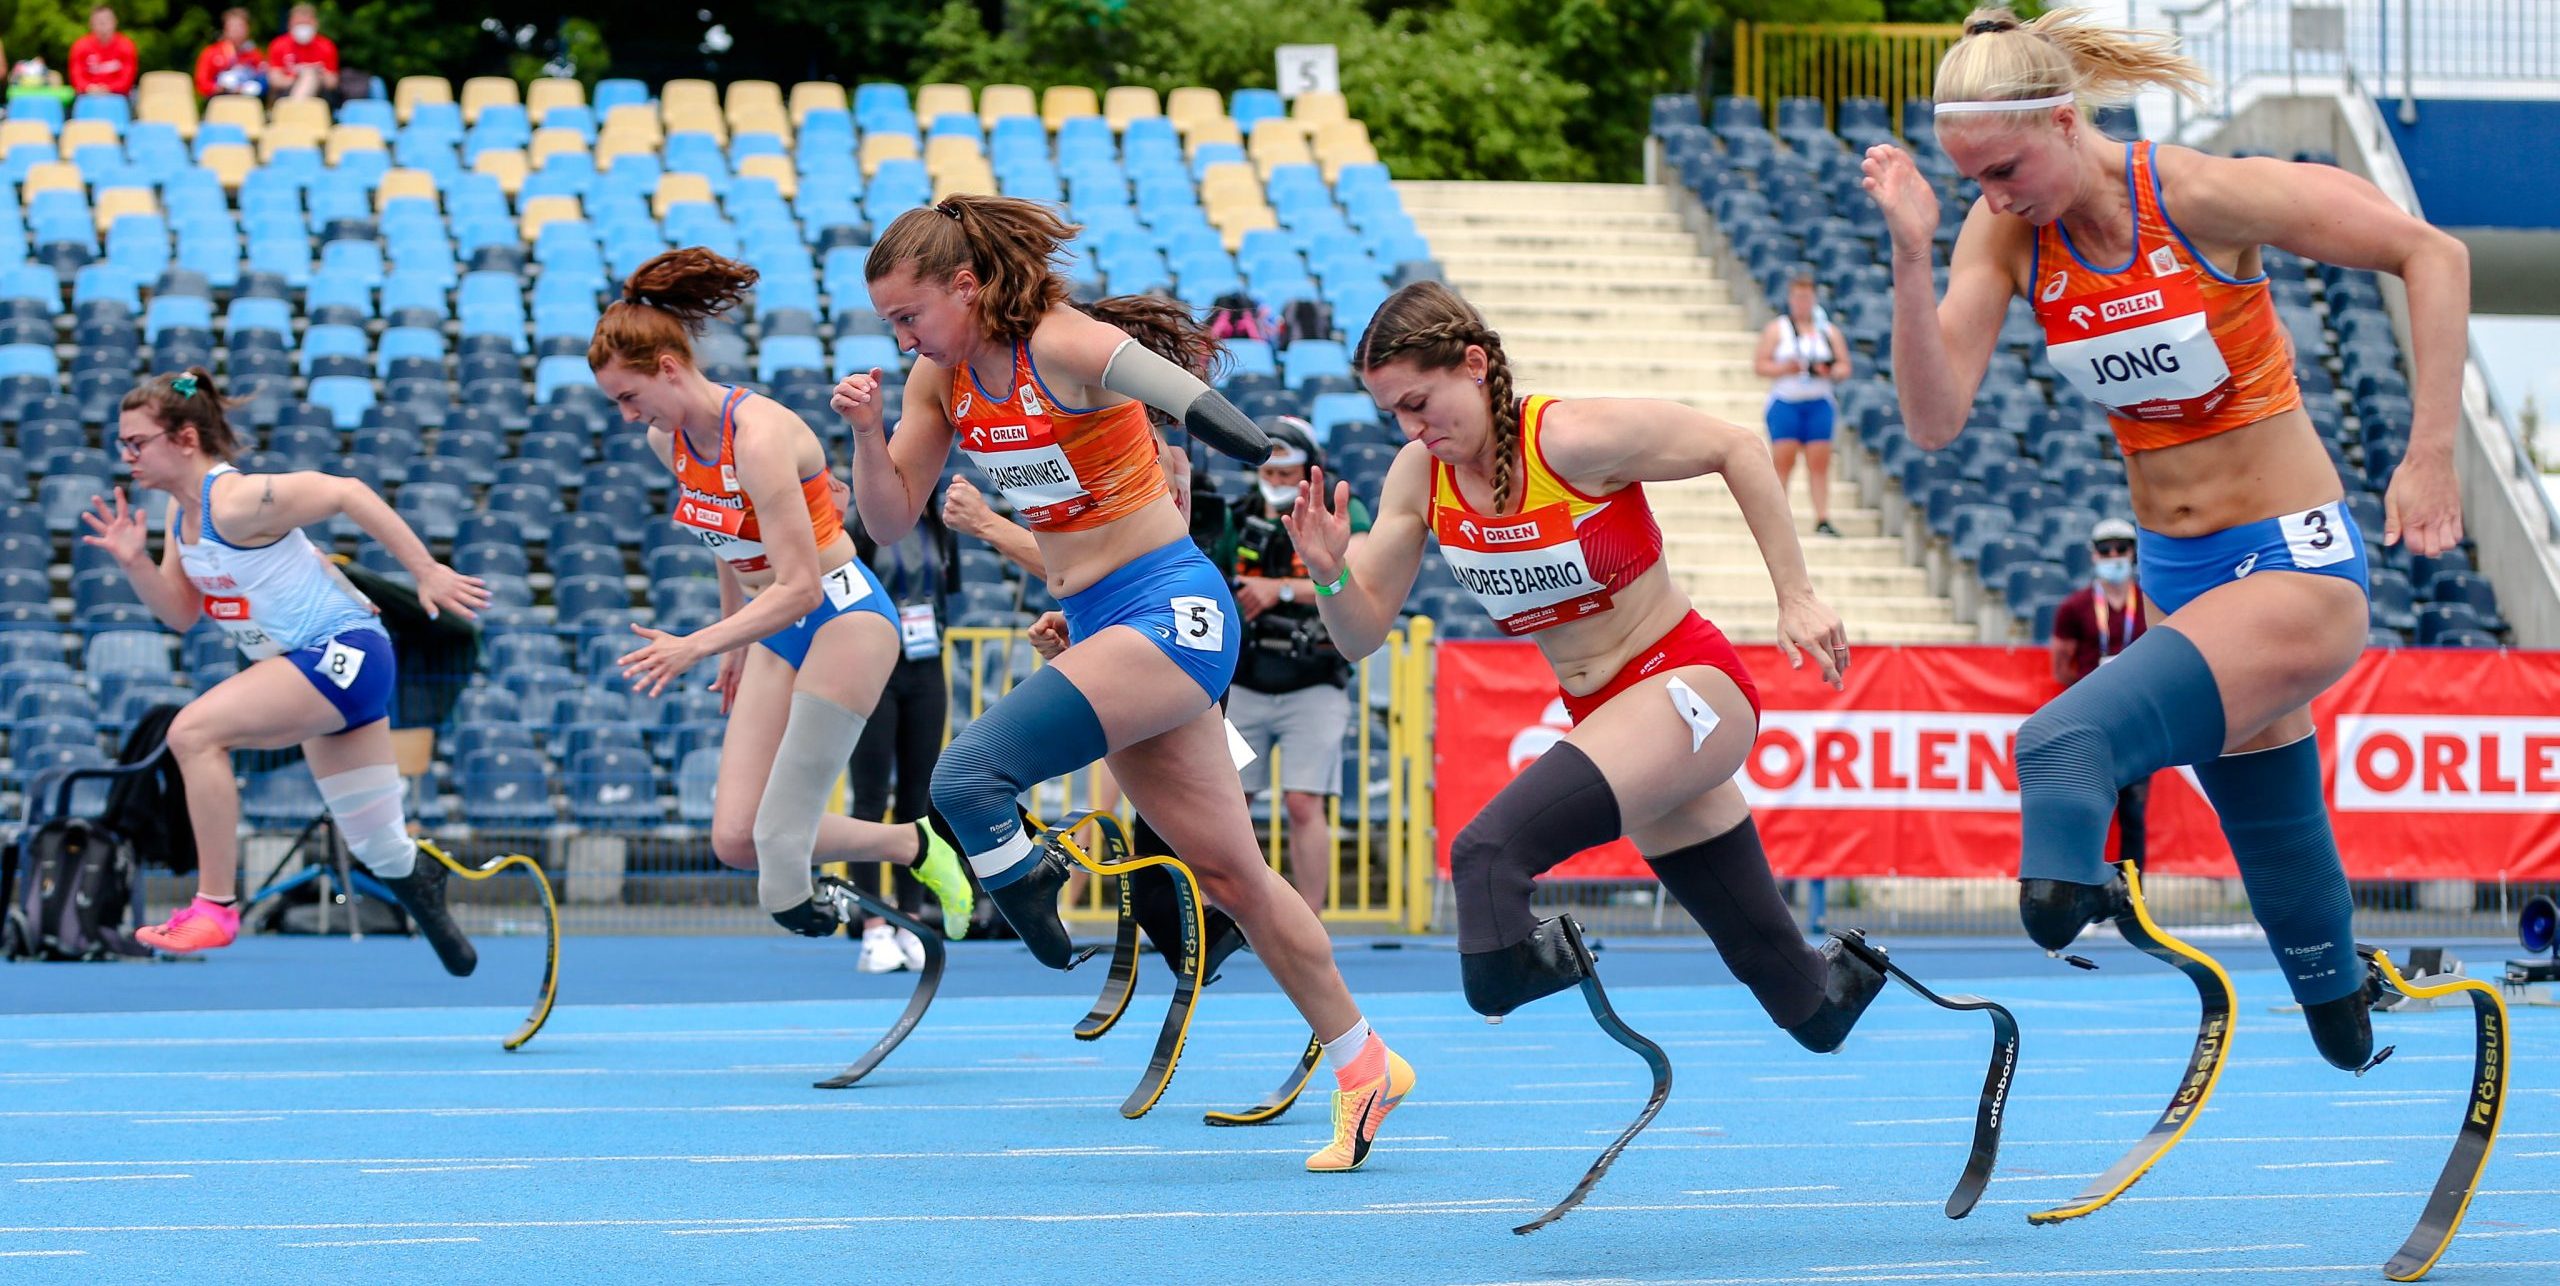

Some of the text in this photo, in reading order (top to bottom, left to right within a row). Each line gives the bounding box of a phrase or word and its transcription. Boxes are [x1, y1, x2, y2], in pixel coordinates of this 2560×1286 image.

[1300, 61, 1318, 91] 5
[2106, 293, 2158, 318] ORLEN
[2090, 342, 2180, 385] JONG
[992, 427, 1025, 441] ORLEN
[1486, 525, 1535, 541] ORLEN
[2304, 510, 2334, 550] 3
[830, 569, 850, 596] 7
[1510, 561, 1583, 594] BARRIO
[1189, 606, 1209, 638] 5
[332, 653, 346, 675] 8
[1745, 728, 2019, 791] ORLEN
[1116, 855, 1131, 917] SSUR
[1181, 881, 1197, 954] ÖSSUR
[2178, 1020, 2223, 1104] ÖSSUR
[2479, 1014, 2498, 1100] ÖSSUR
